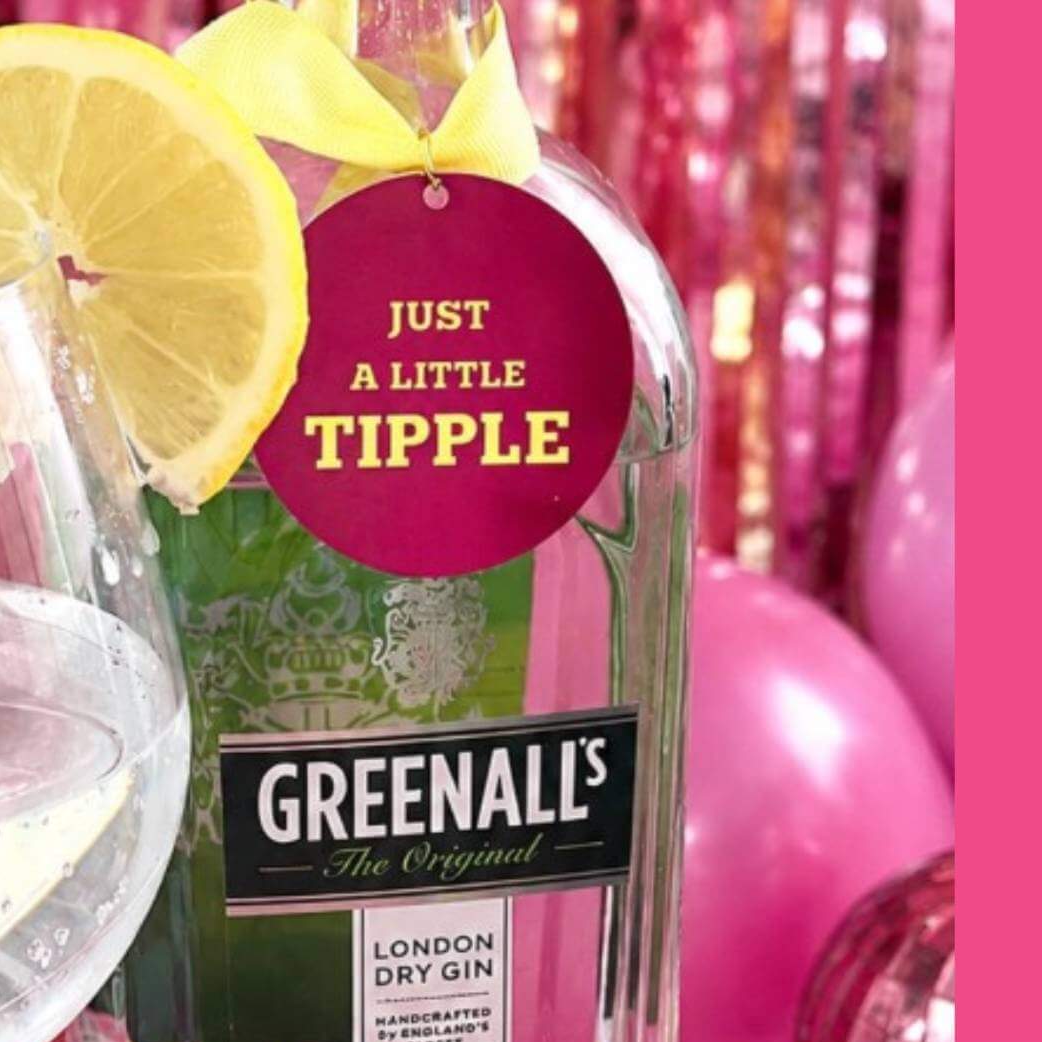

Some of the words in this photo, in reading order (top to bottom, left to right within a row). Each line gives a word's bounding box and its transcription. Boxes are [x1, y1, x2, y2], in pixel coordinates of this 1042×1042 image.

[387, 300, 490, 339] JUST
[349, 363, 379, 391] A
[389, 361, 526, 390] LITTLE
[305, 411, 570, 470] TIPPLE
[258, 737, 607, 843] GREENALL'S
[322, 847, 390, 879] The
[402, 833, 544, 882] Original
[374, 933, 494, 960] LONDON
[375, 964, 433, 986] DRY
[441, 959, 493, 981] GIN
[376, 1008, 492, 1026] HANDCRAFTED
[401, 1022, 490, 1038] ENGLAND'S
